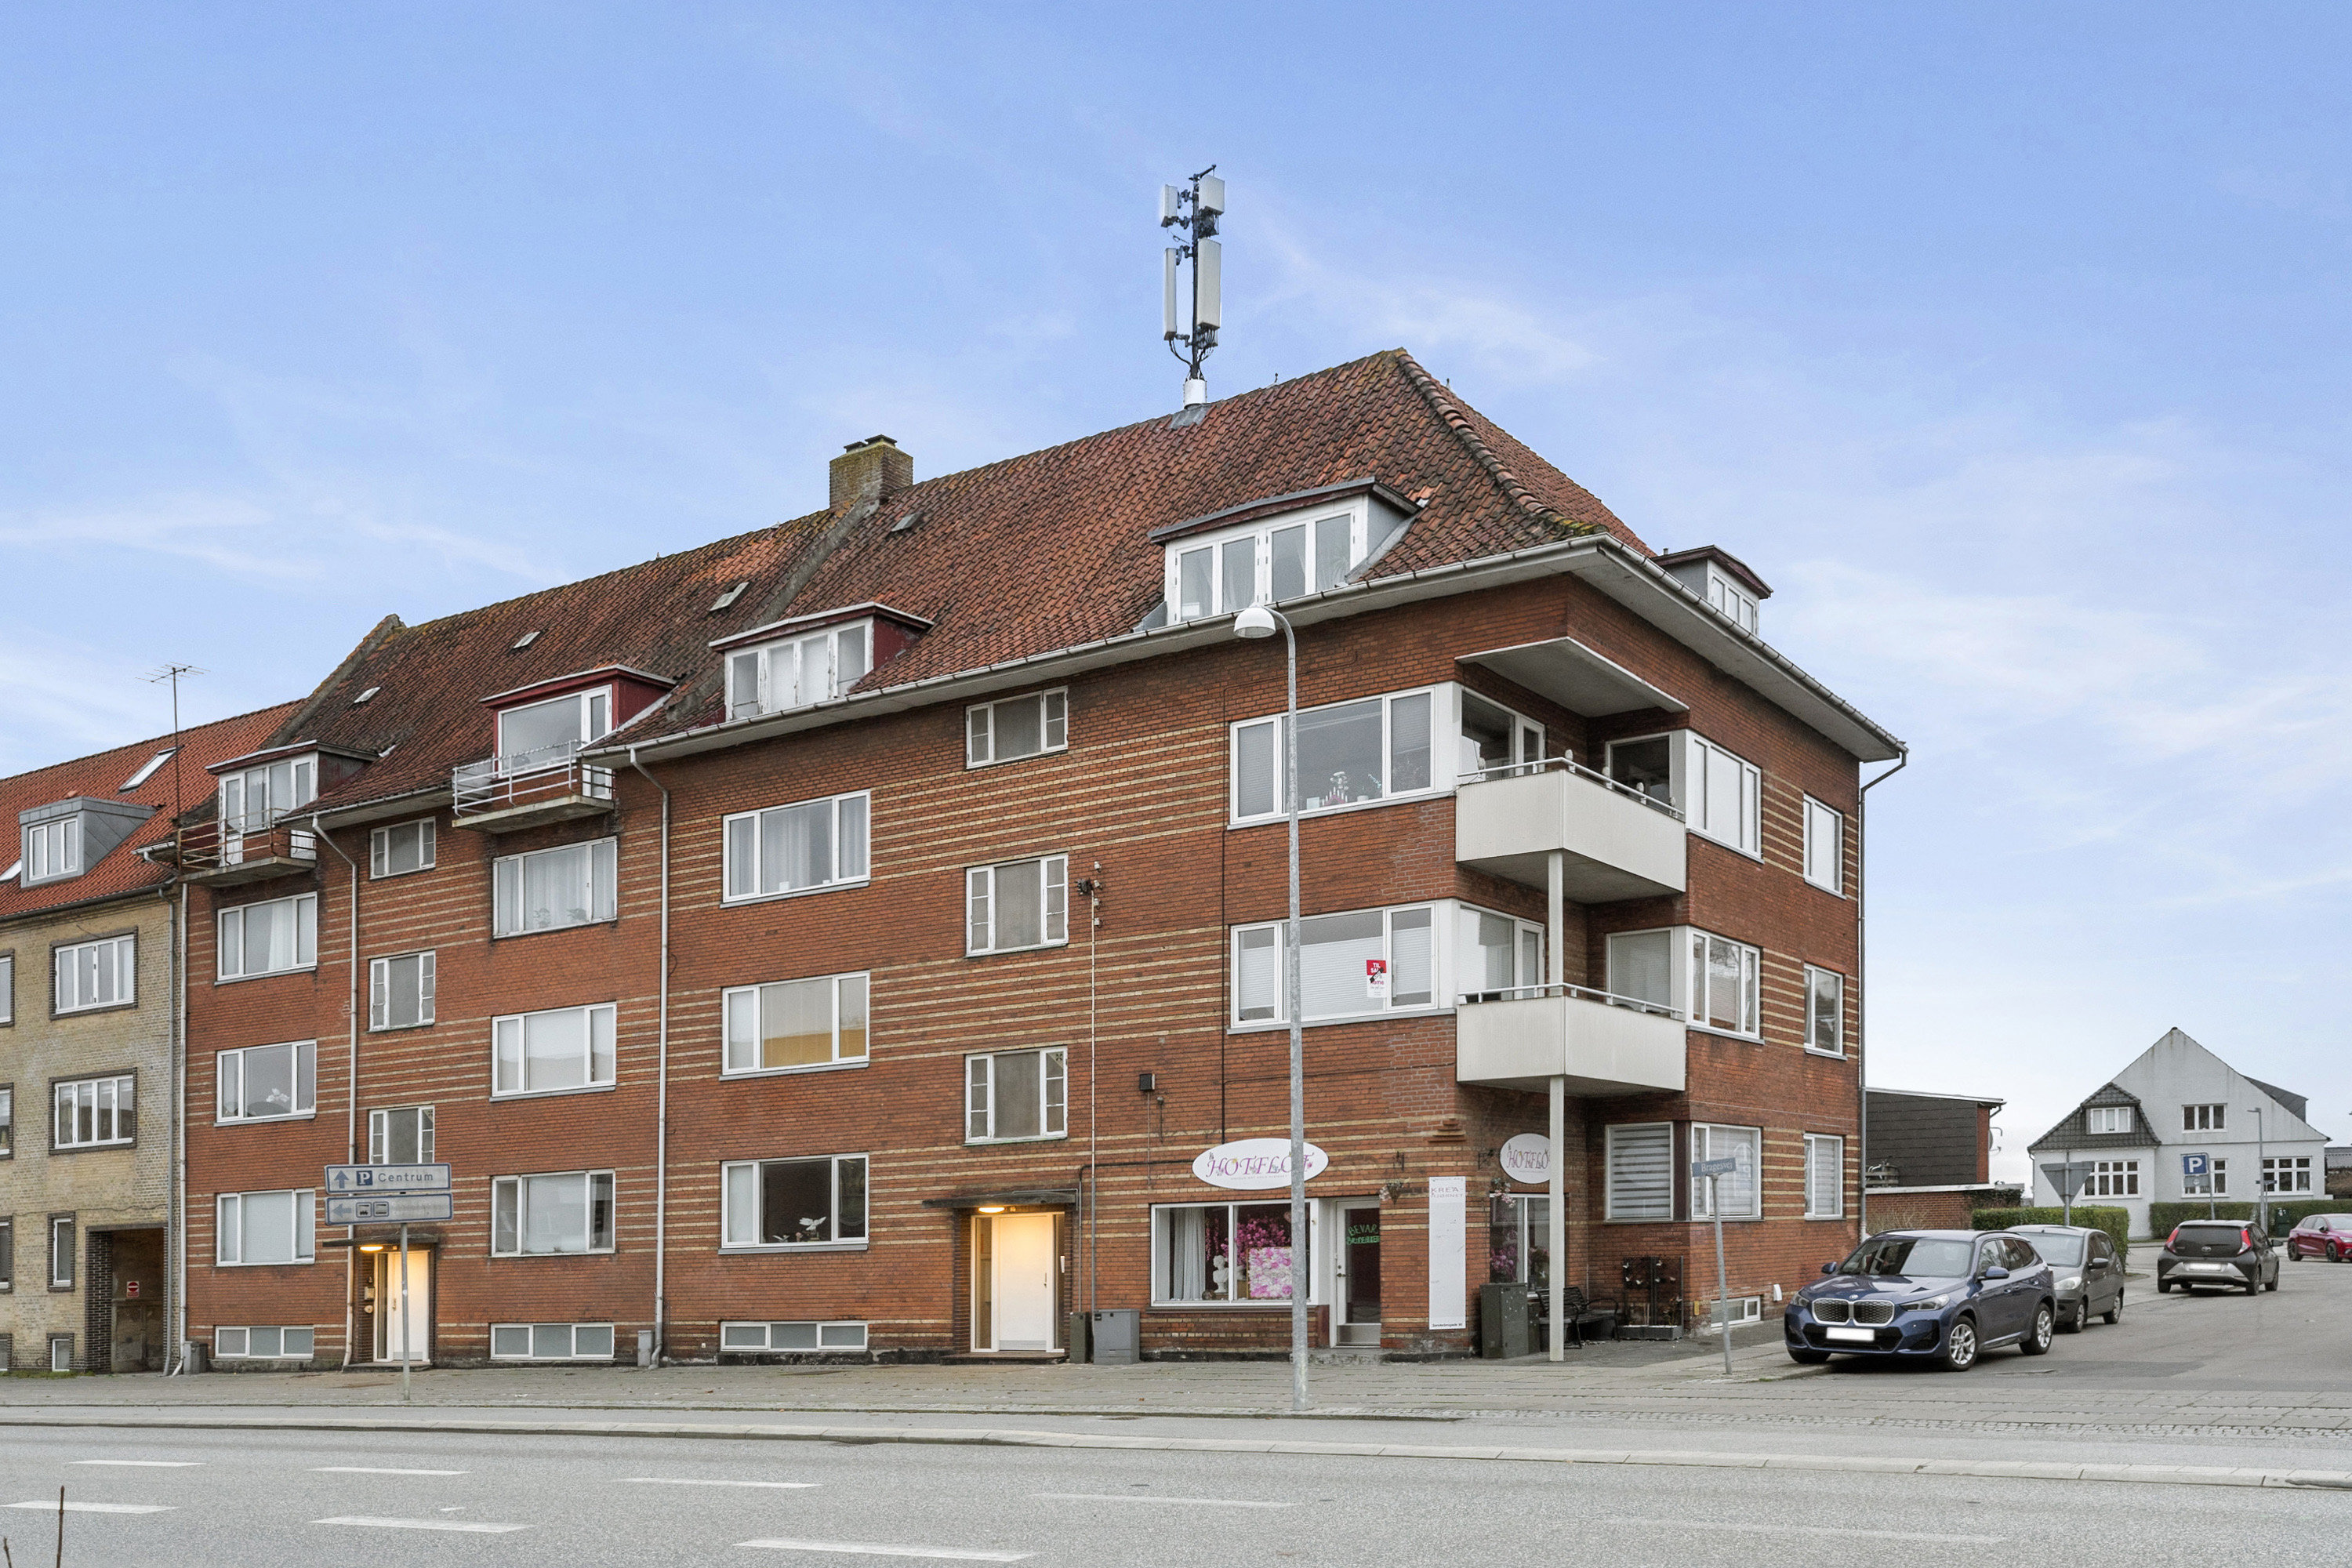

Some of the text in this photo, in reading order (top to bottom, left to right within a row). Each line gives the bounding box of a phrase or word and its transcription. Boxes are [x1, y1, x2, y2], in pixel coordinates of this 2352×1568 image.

[1507, 1150, 1550, 1169] HOTFLO
[2188, 1157, 2202, 1173] P
[1701, 1161, 1733, 1173] Bragesvej
[358, 1171, 434, 1185] P Centrum
[1348, 1224, 1379, 1236] BEVAR
